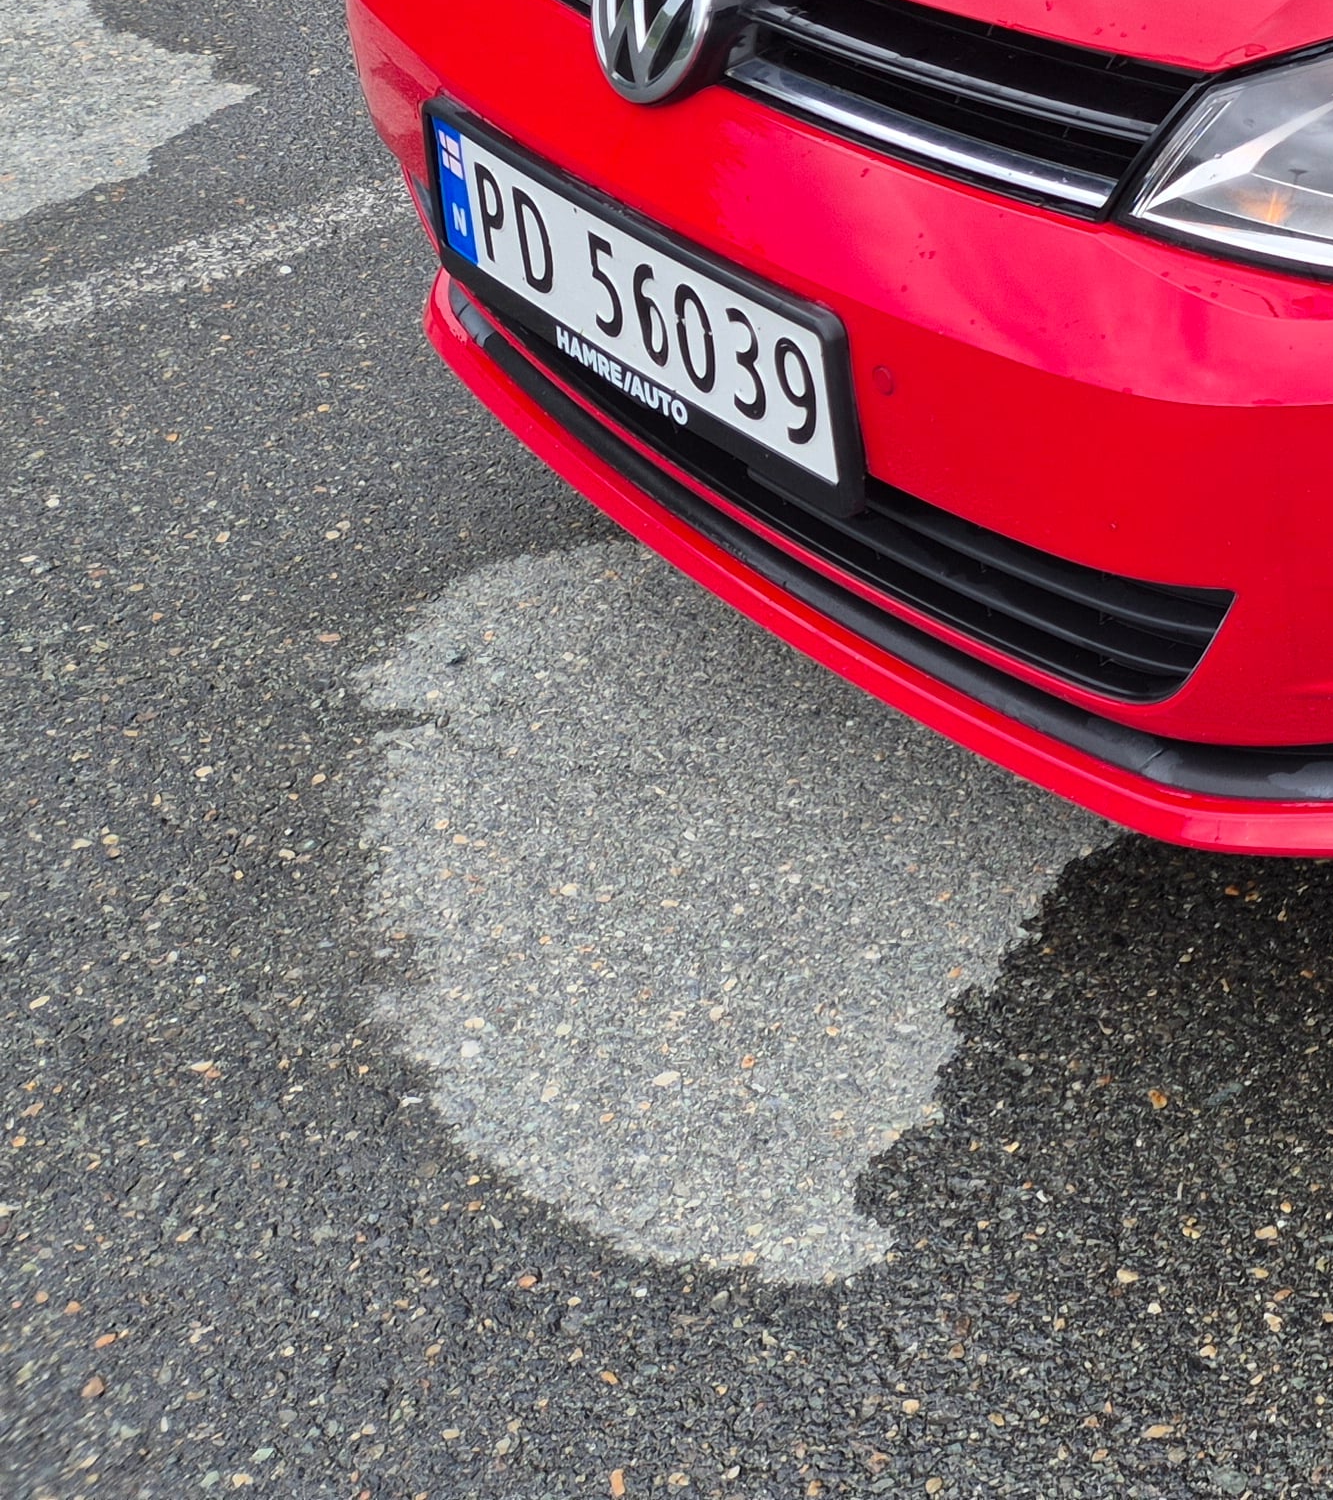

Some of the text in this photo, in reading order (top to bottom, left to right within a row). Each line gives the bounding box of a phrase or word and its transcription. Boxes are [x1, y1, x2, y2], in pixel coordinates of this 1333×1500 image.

[452, 202, 468, 237] N
[474, 161, 818, 444] PD 56039
[555, 326, 690, 427] HAMRE/AUTO
